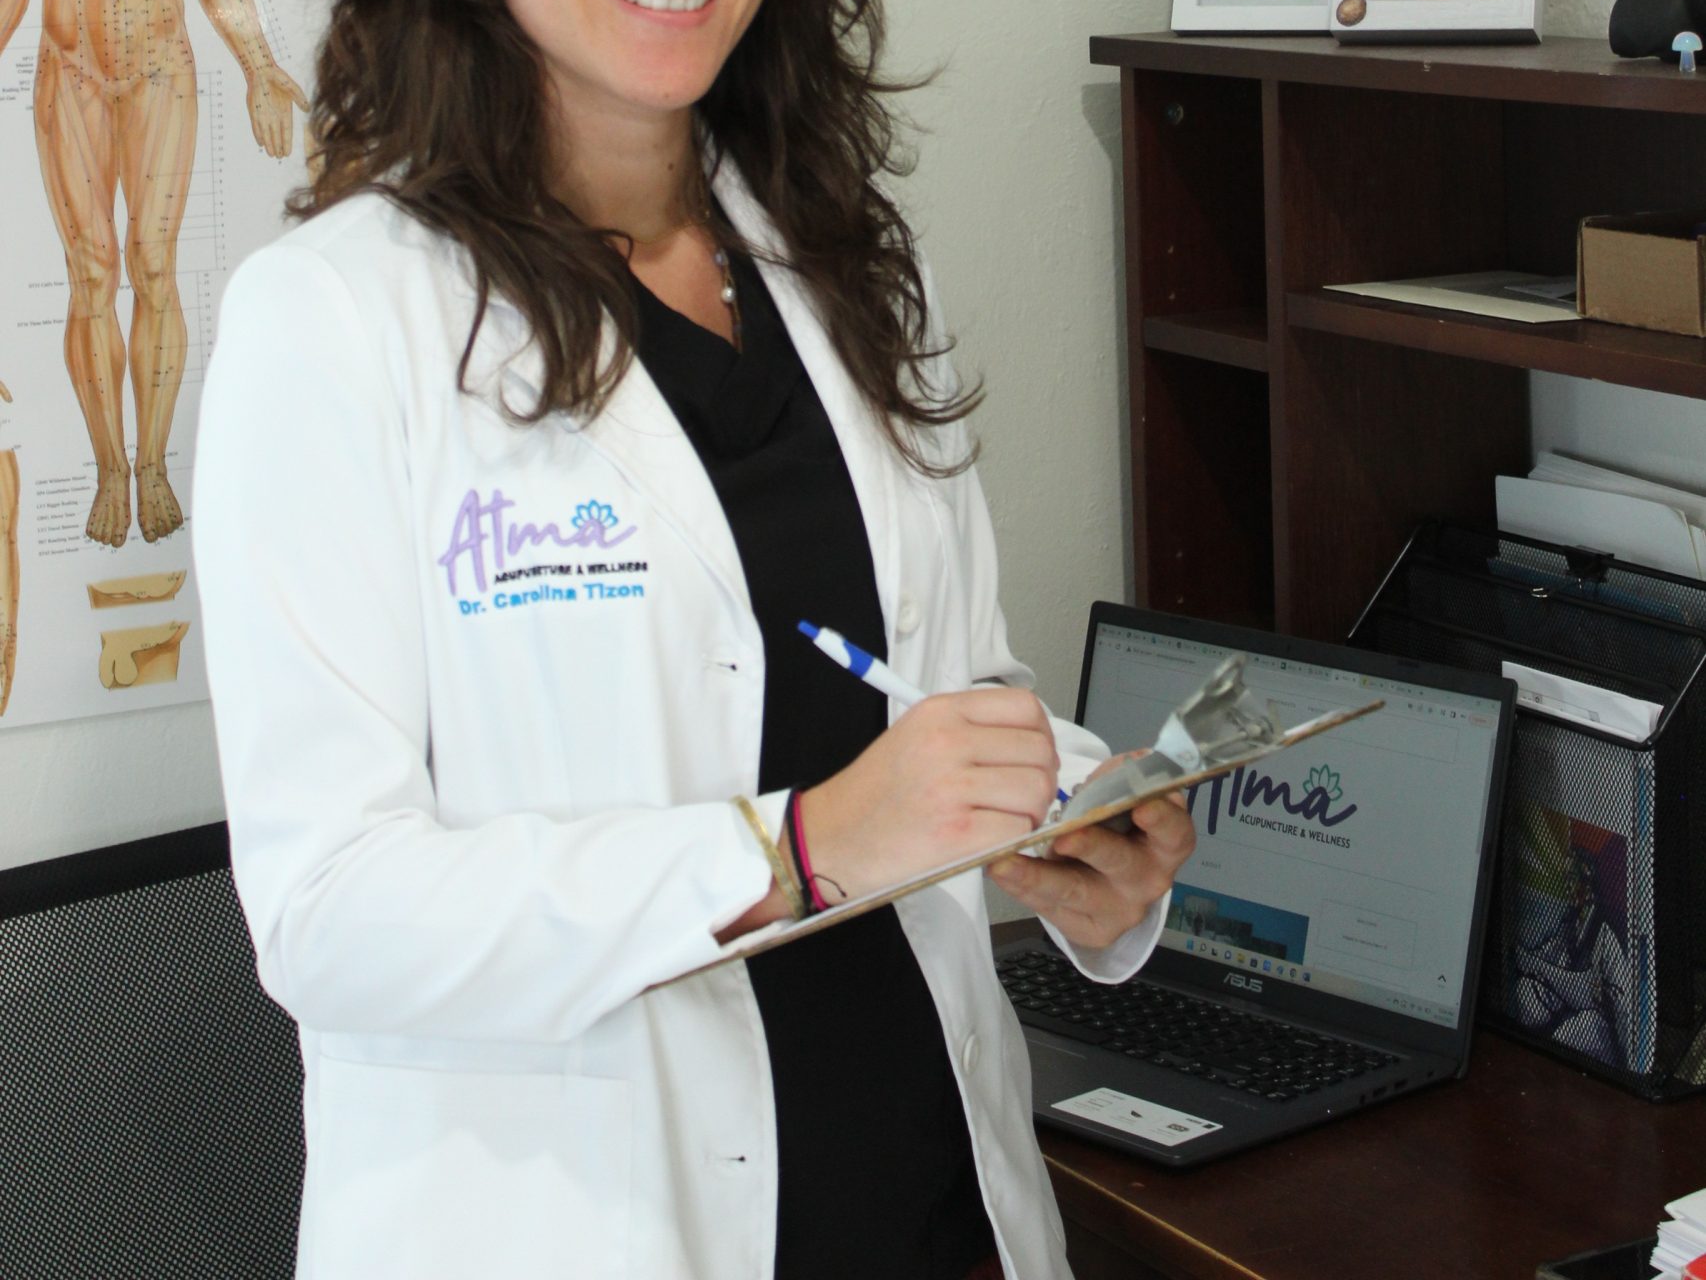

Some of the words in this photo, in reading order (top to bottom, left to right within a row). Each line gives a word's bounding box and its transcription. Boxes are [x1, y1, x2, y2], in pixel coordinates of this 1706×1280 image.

[586, 561, 648, 575] WELLNESS
[458, 600, 487, 616] Dr.
[493, 583, 577, 609] Carolina
[583, 582, 645, 601] Tizon
[1239, 813, 1299, 836] ACUPUNCTURE
[1299, 828, 1306, 838] &
[1308, 829, 1351, 849] WELLNESS
[1223, 972, 1264, 993] ASUS
